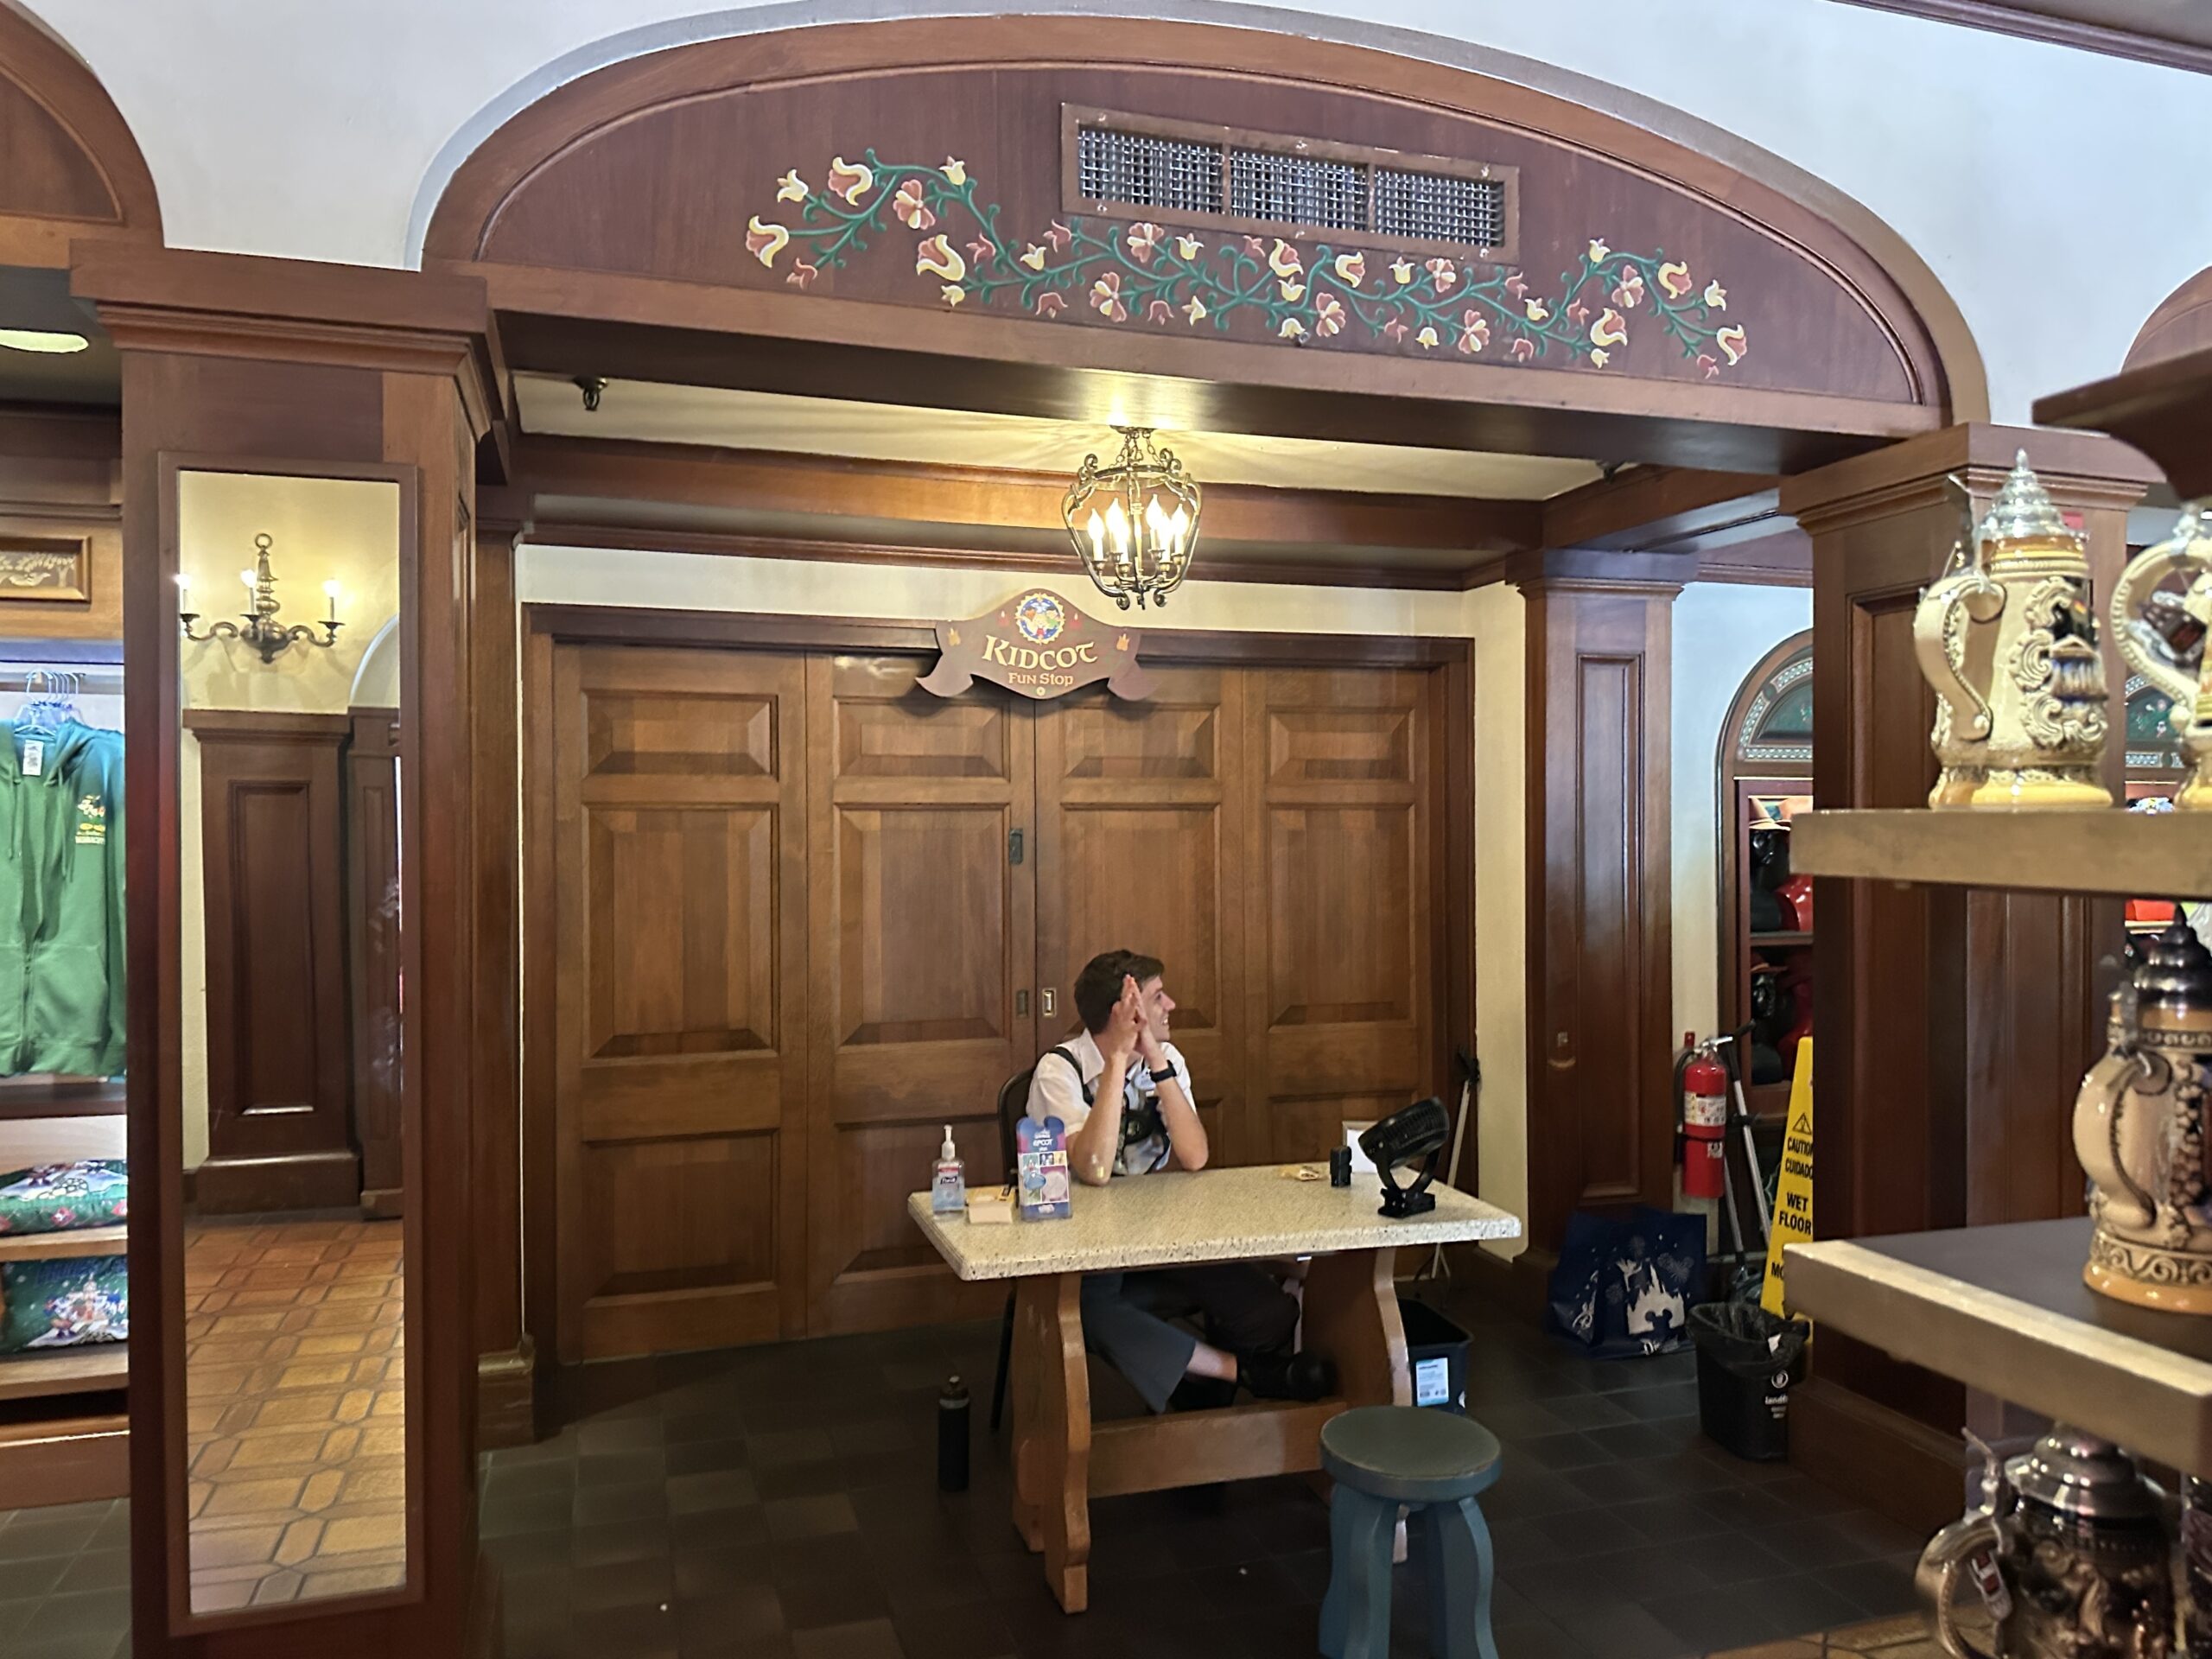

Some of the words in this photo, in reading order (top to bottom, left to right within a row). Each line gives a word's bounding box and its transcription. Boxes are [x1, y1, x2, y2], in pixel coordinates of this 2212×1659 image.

[982, 634, 1098, 671] KIDCOT
[1787, 1192, 1808, 1212] WET
[1779, 1211, 1812, 1235] FLOOR
